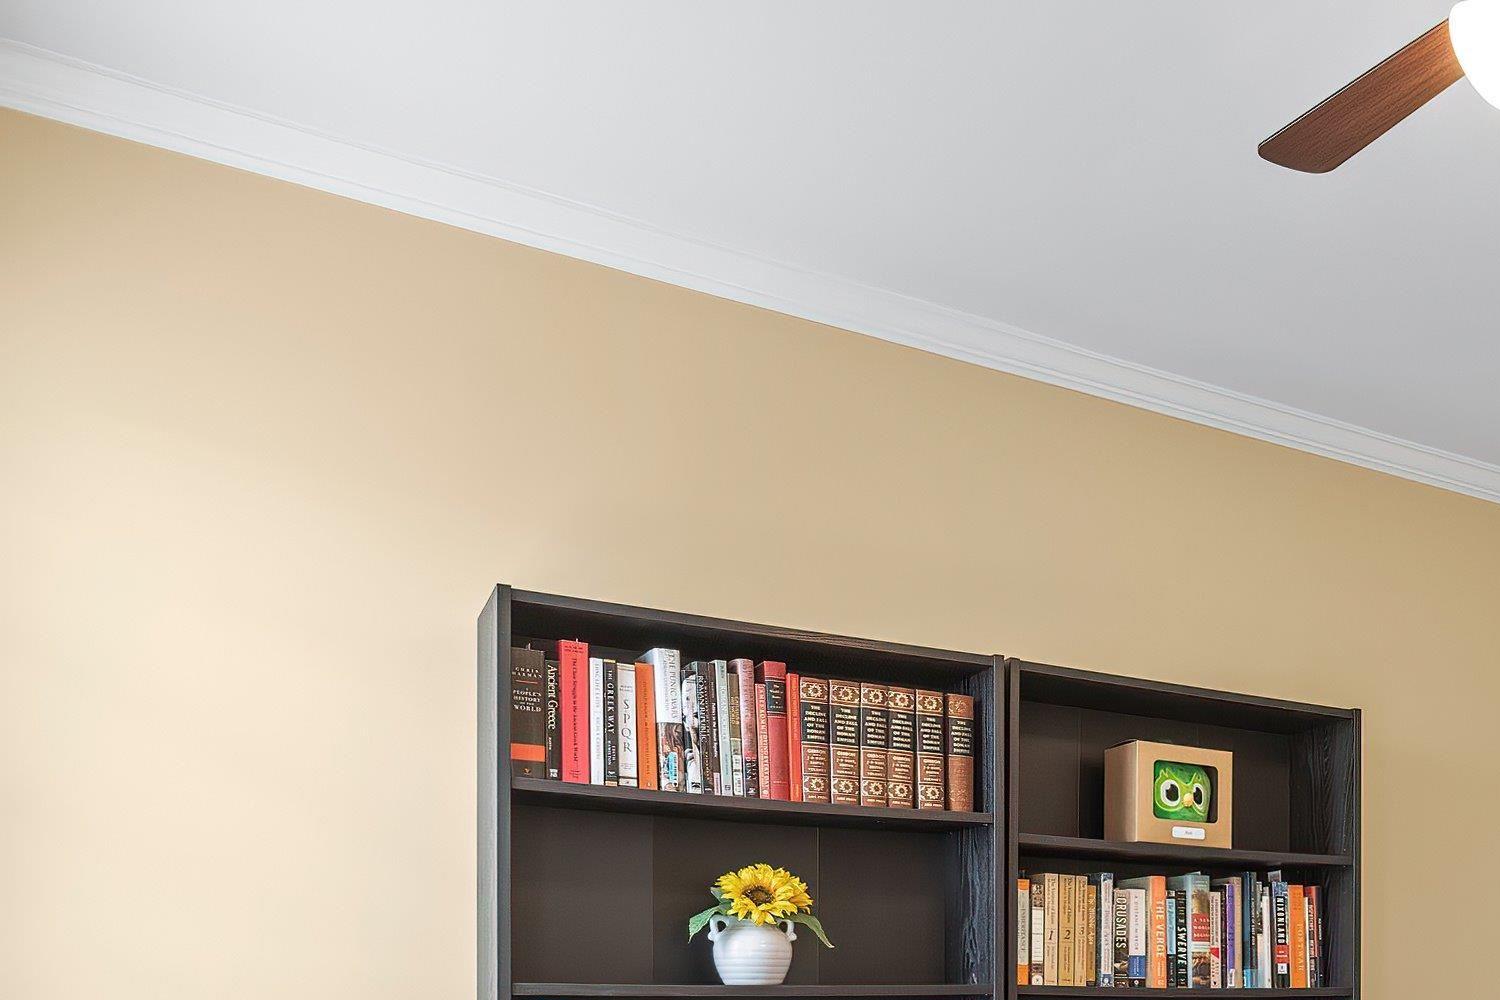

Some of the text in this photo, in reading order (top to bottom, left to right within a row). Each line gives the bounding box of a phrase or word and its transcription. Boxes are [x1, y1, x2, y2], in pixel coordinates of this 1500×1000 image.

[548, 665, 558, 729] Ancient Greece
[668, 653, 678, 719] THE PUNIC WARS
[1064, 930, 1070, 940] 2
[1116, 898, 1127, 948] CRUSADES
[1156, 900, 1165, 958] THE VERGE
[1177, 926, 1187, 965] SWERVE
[1276, 897, 1285, 944] NIXONLAND
